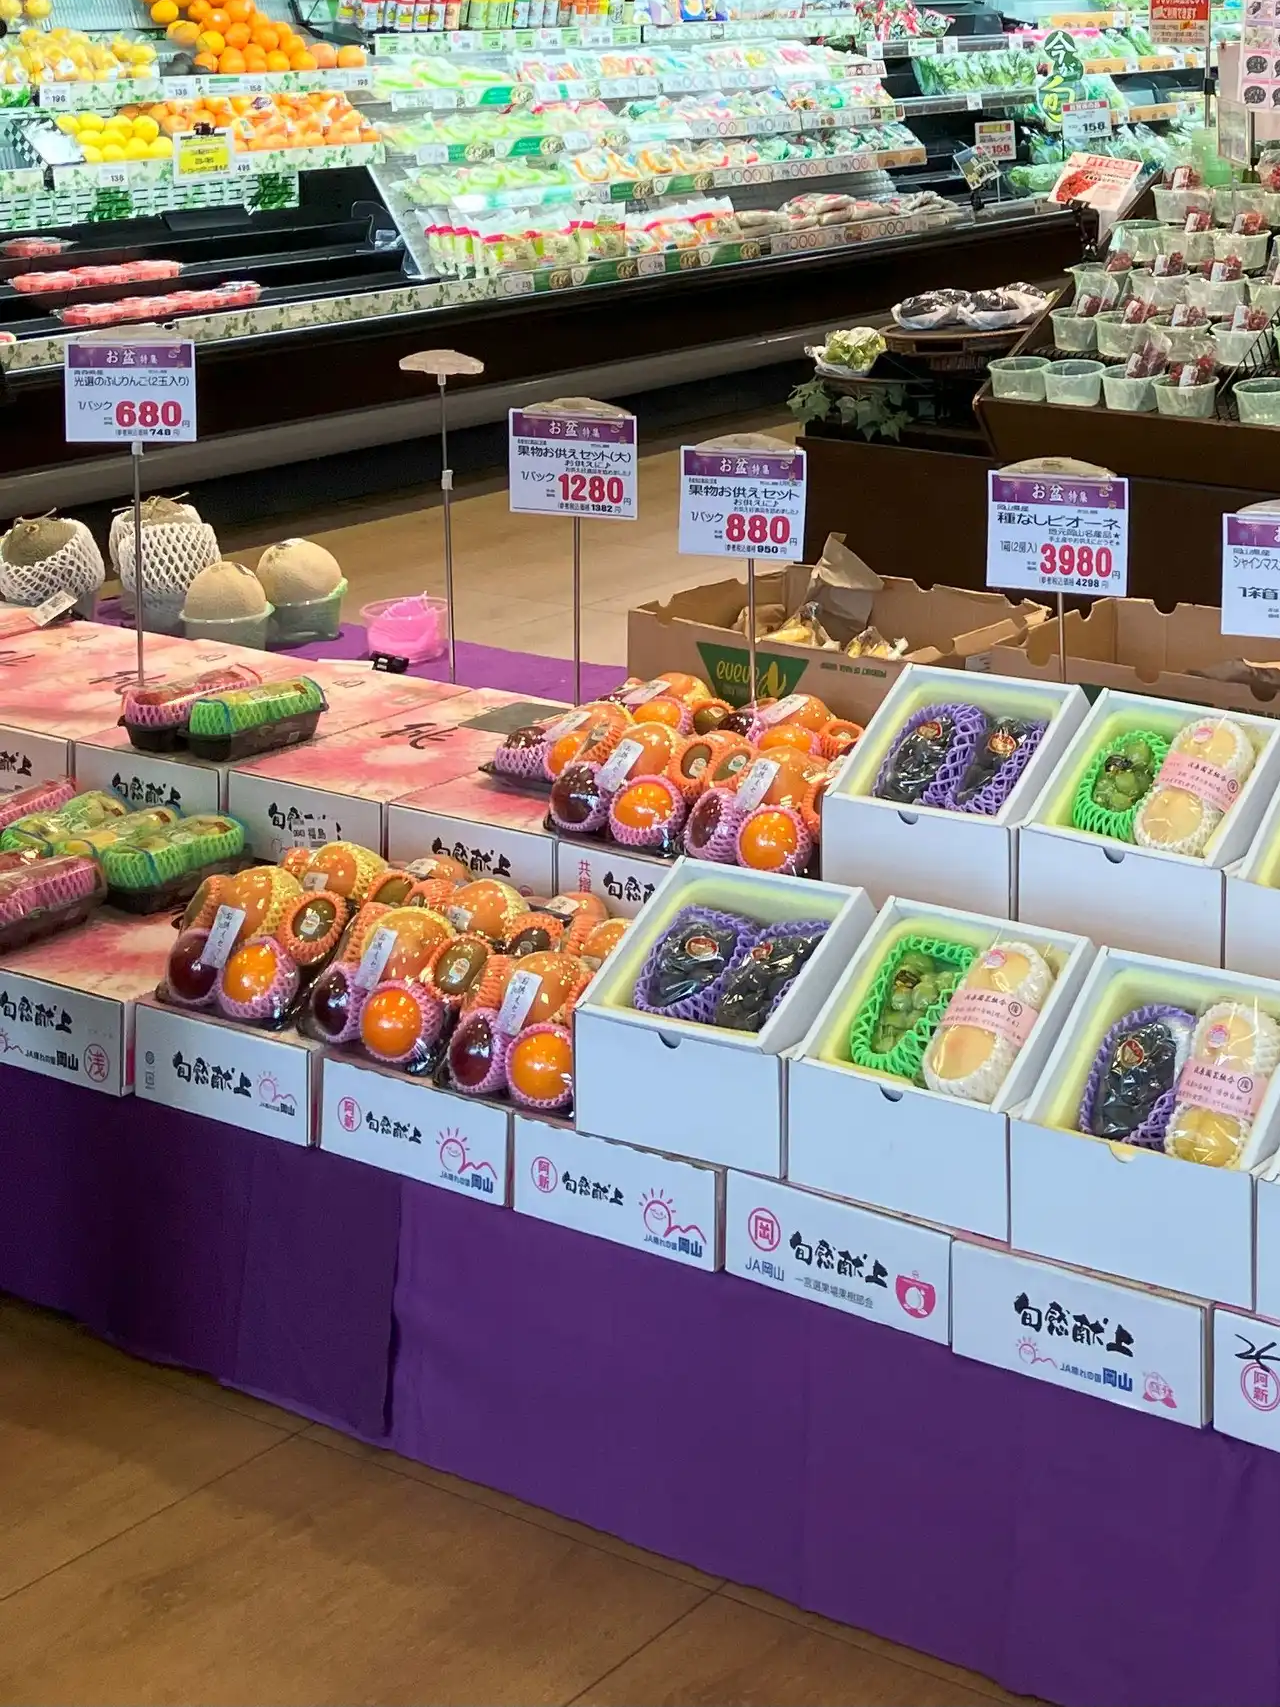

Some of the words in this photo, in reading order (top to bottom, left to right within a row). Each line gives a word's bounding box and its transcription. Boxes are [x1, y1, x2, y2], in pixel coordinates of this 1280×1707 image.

[1039, 30, 1078, 124] 今が旬
[1082, 121, 1105, 132] 158
[106, 349, 158, 365] お盆特集
[115, 400, 182, 428] 680
[182, 420, 190, 428] 円
[549, 420, 600, 438] お盆特集
[517, 444, 631, 463] 果物お供えセット(大)
[720, 457, 770, 475] お盆特集
[558, 474, 624, 504] 1280
[624, 497, 632, 505] 円
[689, 485, 800, 500] 果物お供えセット
[1032, 483, 1088, 503] お盆特集
[591, 504, 613, 513] 1382
[726, 513, 790, 544] 880
[790, 538, 797, 546] 円
[997, 512, 1121, 531] 種なしピオーネ
[757, 545, 778, 554] 950
[1040, 543, 1112, 578] 3980
[1112, 570, 1120, 580] 円
[1075, 578, 1100, 588] 4298
[745, 1256, 785, 1282] JA岡山
[1252, 1369, 1270, 1406] 阿新
